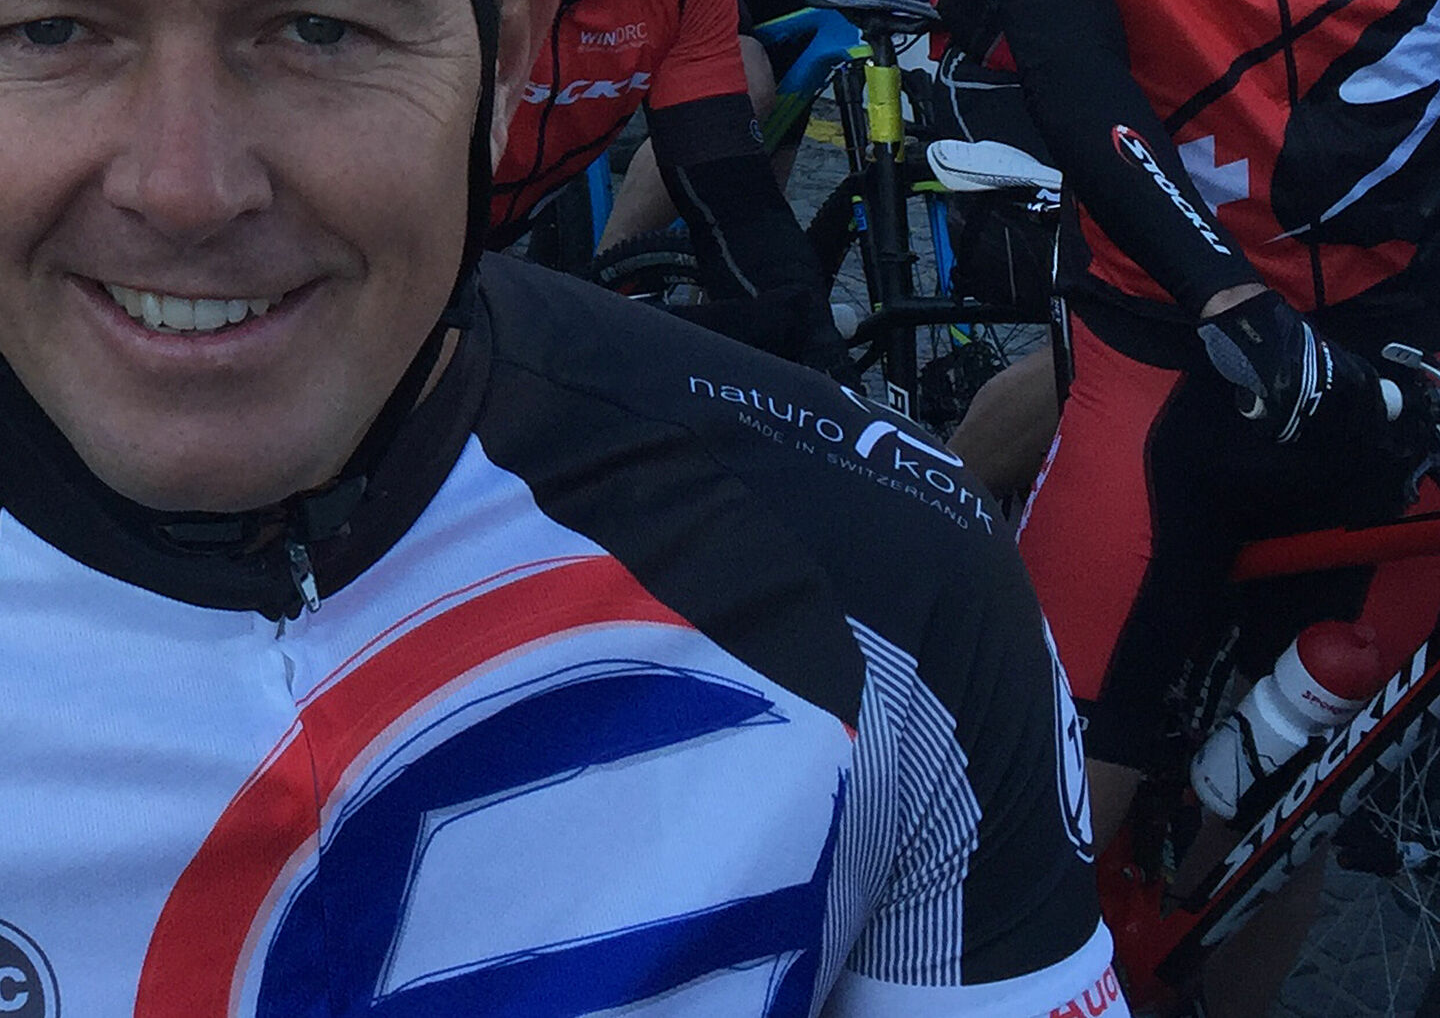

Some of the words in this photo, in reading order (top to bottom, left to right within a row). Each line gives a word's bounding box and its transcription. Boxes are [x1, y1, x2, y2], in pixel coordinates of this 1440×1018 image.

[688, 373, 845, 444] naturo
[893, 446, 994, 536] kork
[737, 411, 785, 445] MADE
[795, 439, 816, 456] IN
[826, 452, 970, 531] SWITZERLAND
